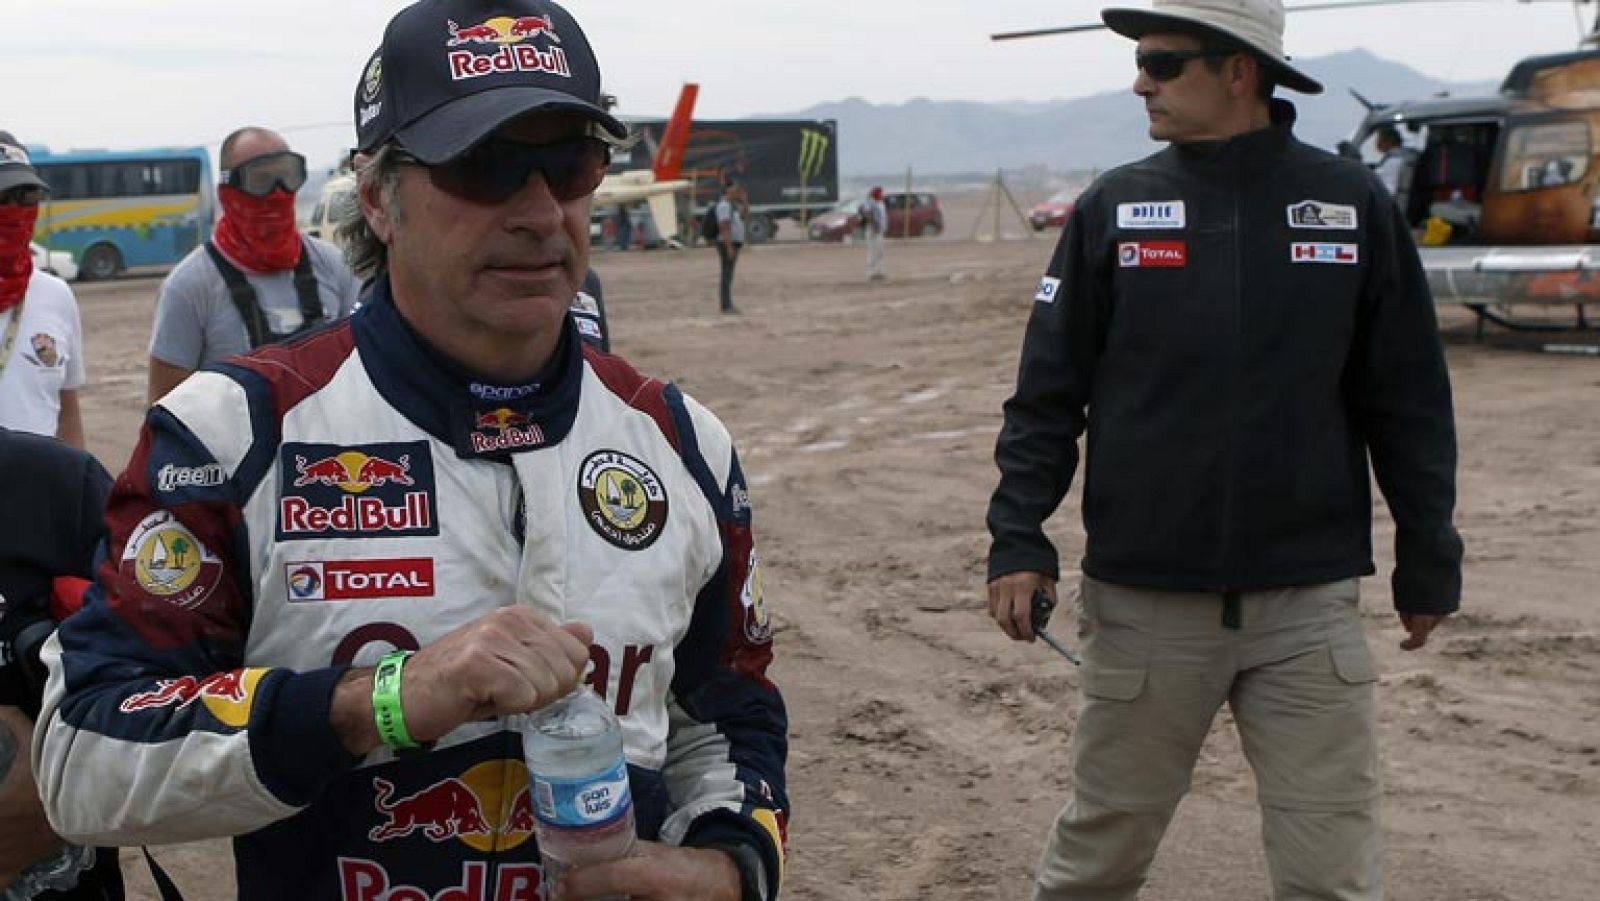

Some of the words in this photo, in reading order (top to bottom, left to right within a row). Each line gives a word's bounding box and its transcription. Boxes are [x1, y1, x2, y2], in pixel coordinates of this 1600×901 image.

[448, 44, 516, 79] Red
[513, 43, 571, 77] Bull
[1140, 247, 1182, 259] TOTAL
[471, 429, 510, 453] Red
[507, 423, 544, 446] Bull
[281, 494, 356, 532] Red
[358, 491, 430, 530] Bull
[326, 570, 430, 590] TOTAL
